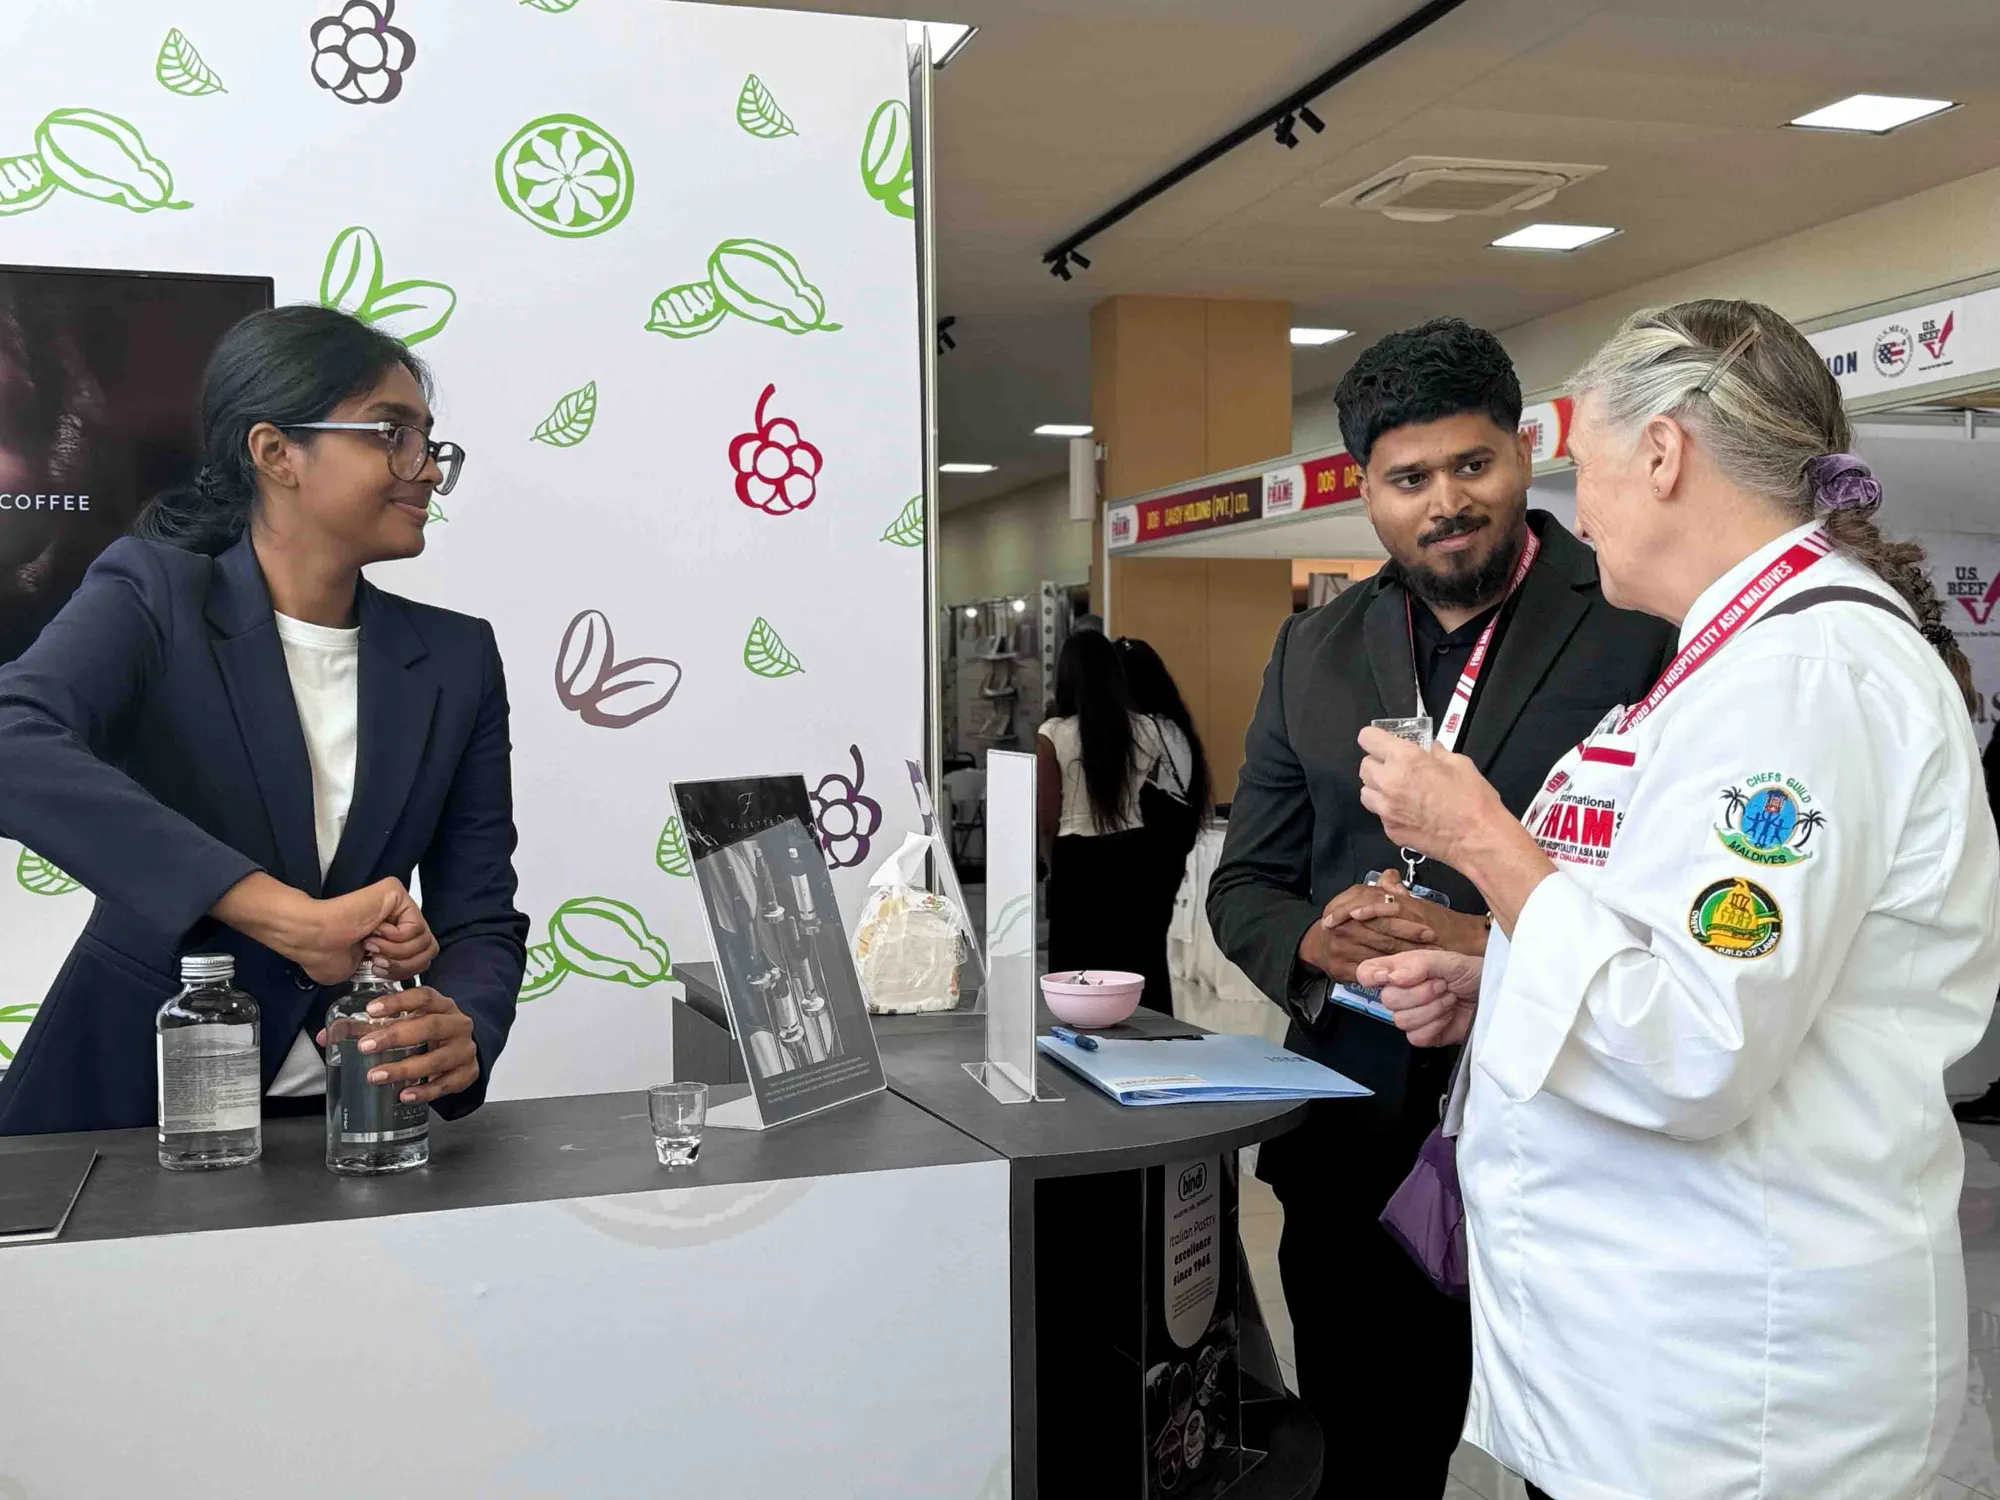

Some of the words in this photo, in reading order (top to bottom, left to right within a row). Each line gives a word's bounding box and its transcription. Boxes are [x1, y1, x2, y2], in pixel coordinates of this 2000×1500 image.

[0, 494, 90, 511] COFFEE
[1955, 567, 1980, 581] U.S.
[1947, 582, 1988, 596] BEEF
[1627, 704, 1650, 730] FOOD
[1649, 686, 1668, 708] AND
[1664, 628, 1722, 688] HOSPITALITY
[1718, 604, 1744, 631] ASIA
[1739, 560, 1793, 611] MALDIVES
[1746, 772, 1782, 788] CHEFS
[1786, 777, 1812, 804] GUILD
[1727, 840, 1787, 864] MALDIVES
[1182, 1167, 1204, 1196] bindi
[1169, 1226, 1193, 1249] Italian
[1174, 1235, 1212, 1265] excellence
[1172, 1267, 1193, 1287] since
